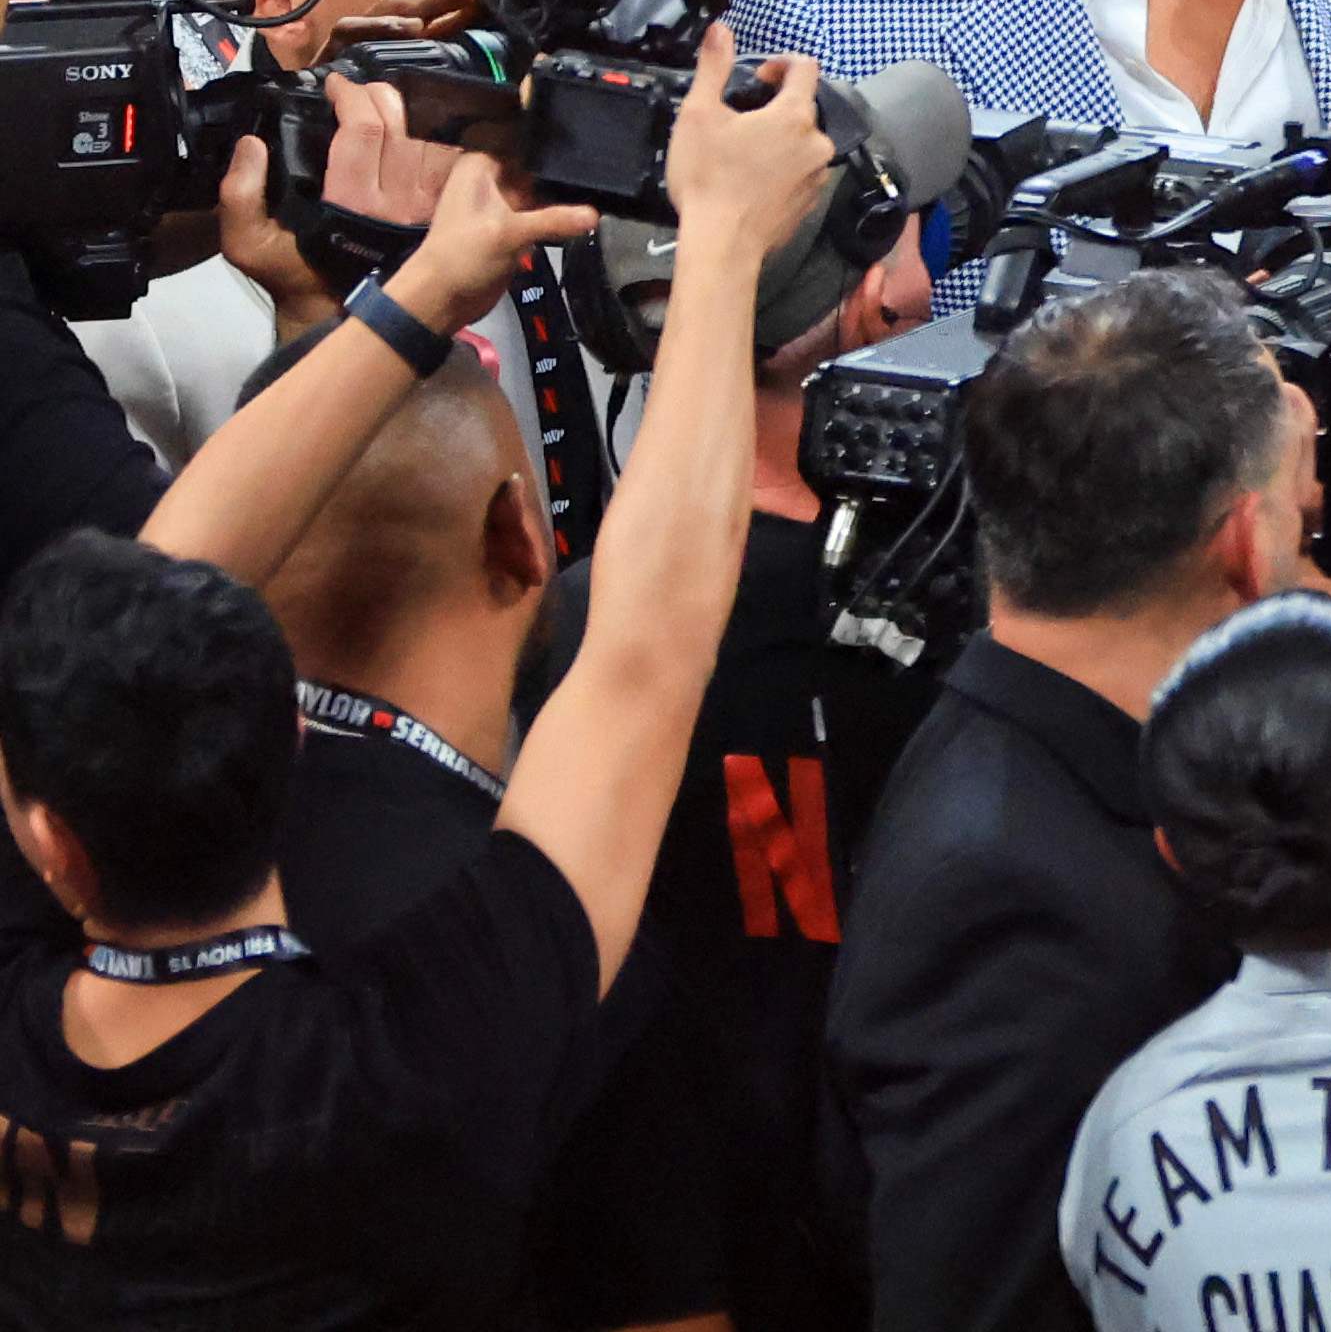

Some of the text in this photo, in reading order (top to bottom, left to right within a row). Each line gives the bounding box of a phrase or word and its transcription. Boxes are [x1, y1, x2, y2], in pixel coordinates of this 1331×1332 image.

[65, 64, 134, 82] SONY
[97, 122, 108, 139] 3
[723, 753, 842, 943] N
[1095, 1084, 1278, 1296] TEAM
